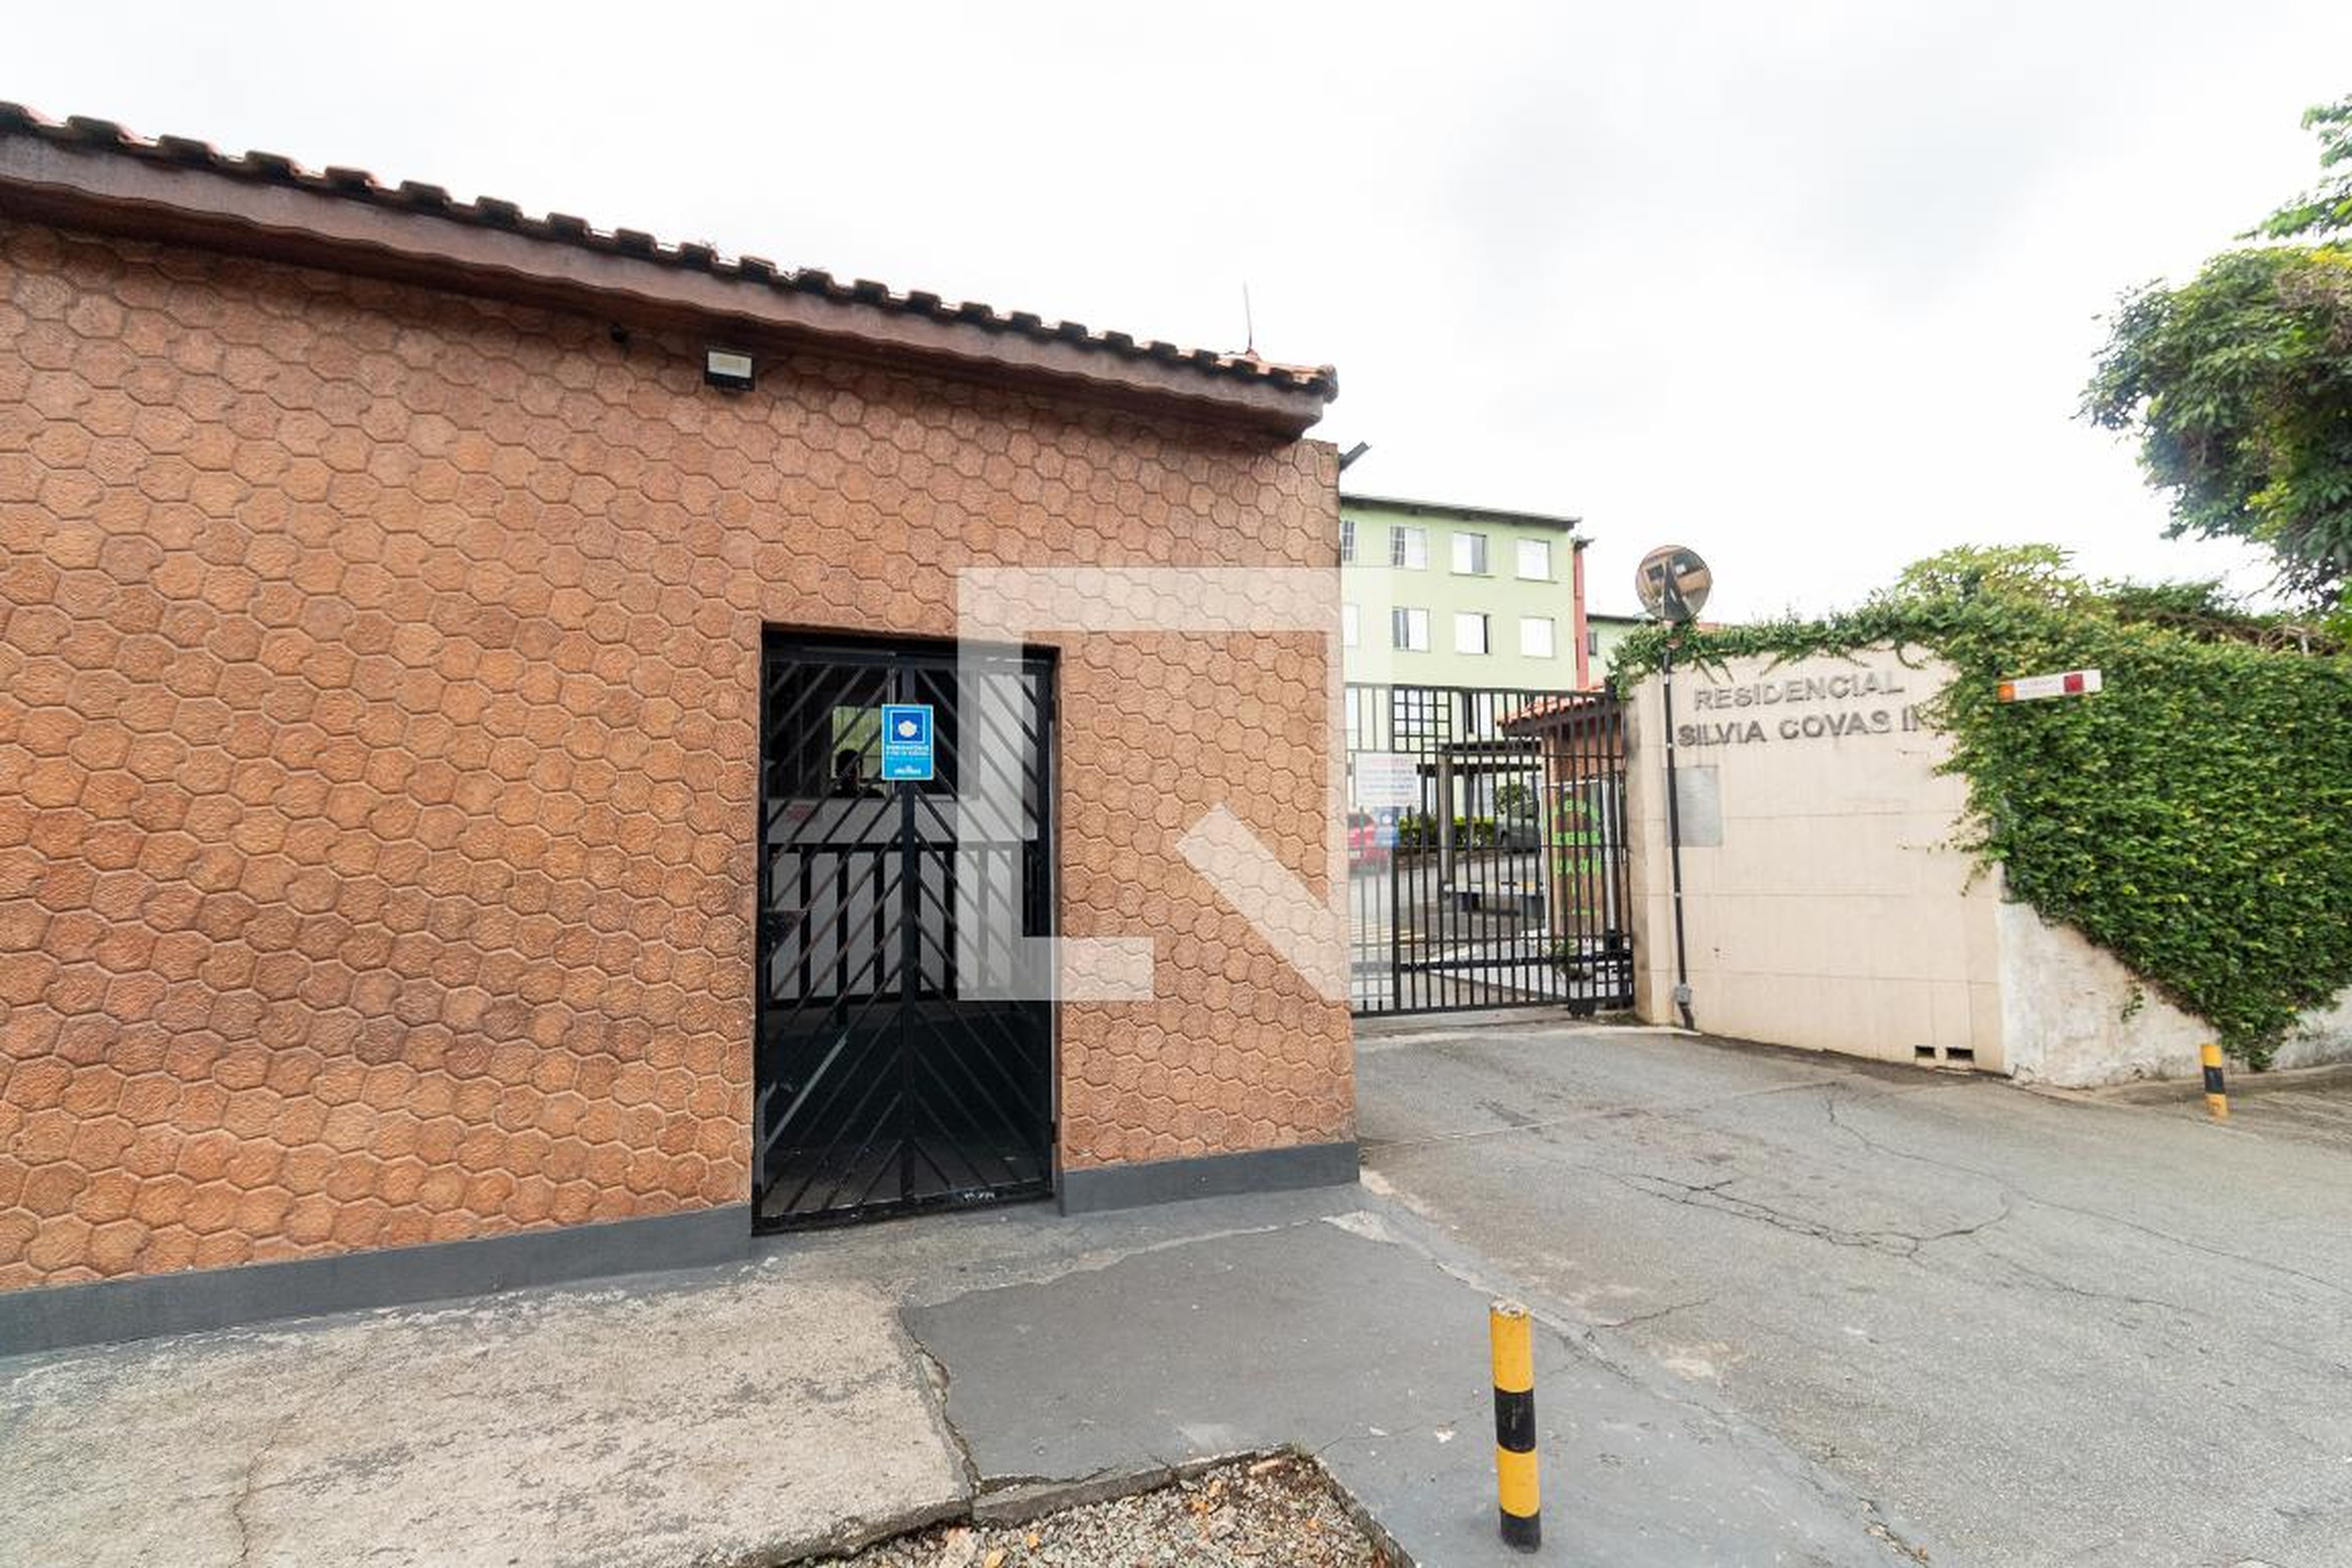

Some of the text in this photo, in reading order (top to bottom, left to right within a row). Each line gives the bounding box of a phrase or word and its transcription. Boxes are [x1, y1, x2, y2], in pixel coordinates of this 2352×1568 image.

[1694, 671, 1905, 712] RESIDENCIAL
[1678, 720, 1768, 747] SILVIA
[1778, 709, 1891, 741] COVAS
